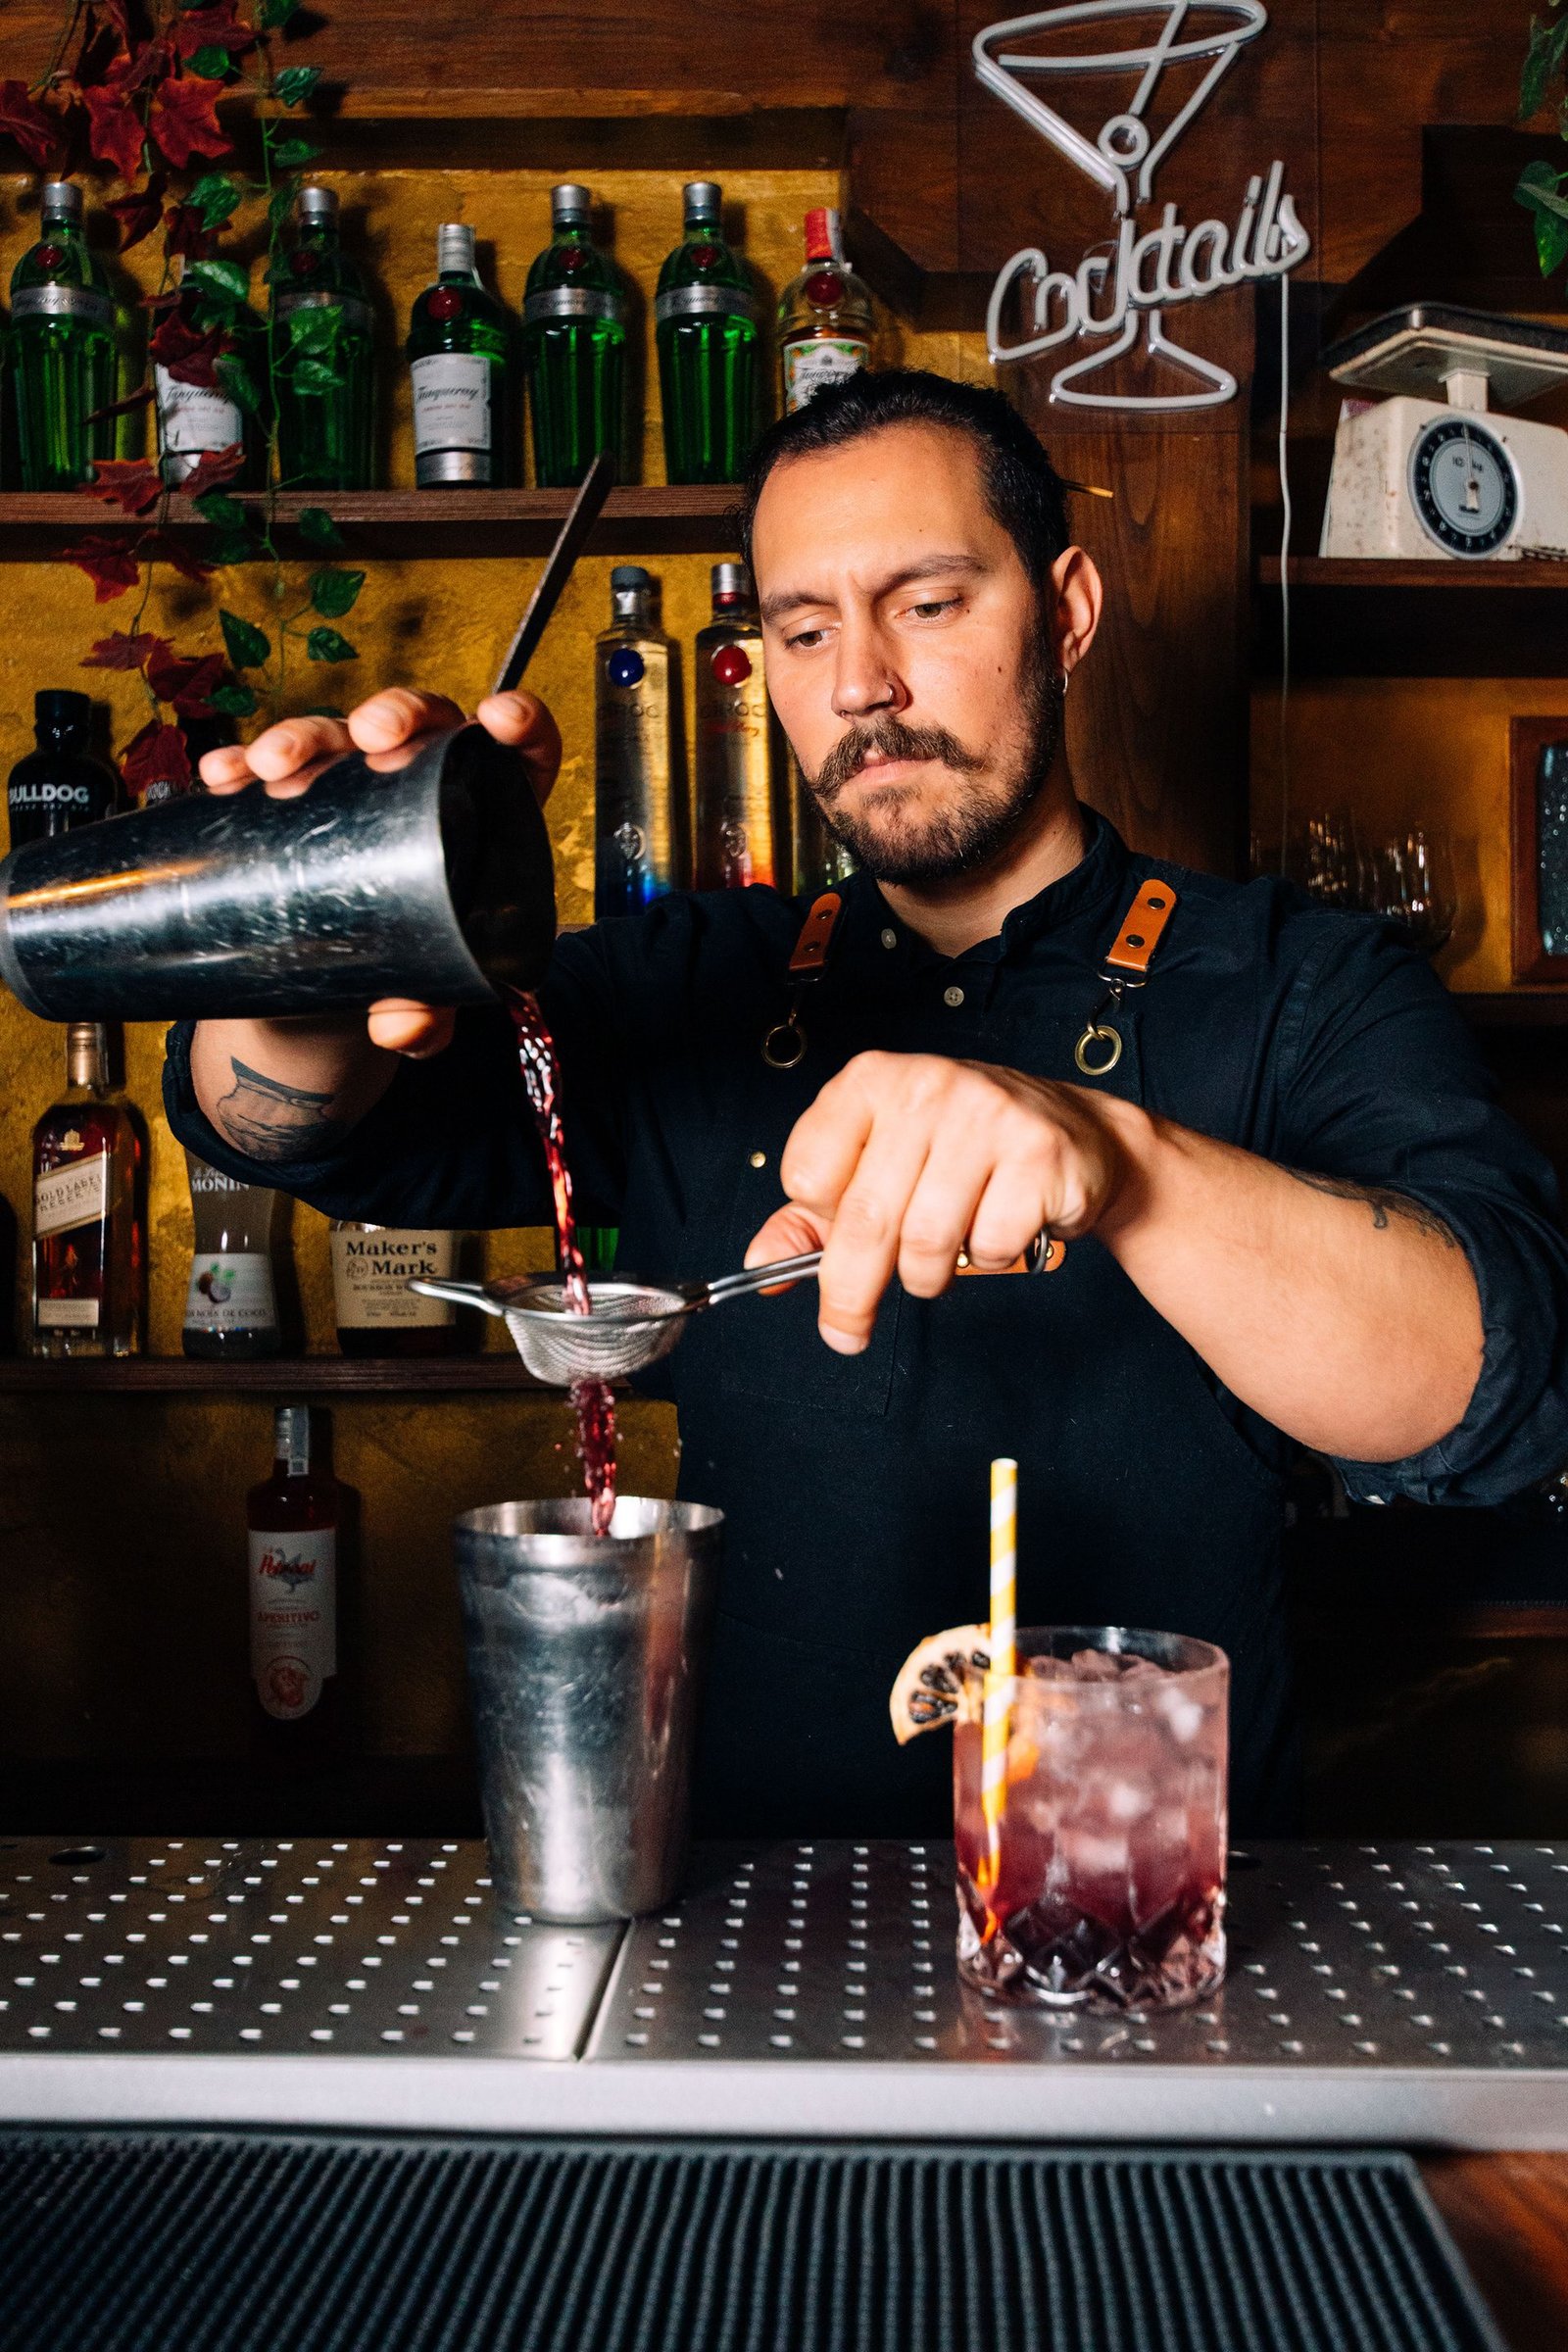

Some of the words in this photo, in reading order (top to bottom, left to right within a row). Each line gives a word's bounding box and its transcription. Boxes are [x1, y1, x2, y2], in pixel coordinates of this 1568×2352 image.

[987, 161, 1309, 364] Cocktails
[416, 385, 479, 403] Tanqueray
[346, 1240, 438, 1256] Maker's
[371, 1259, 436, 1275] Mark
